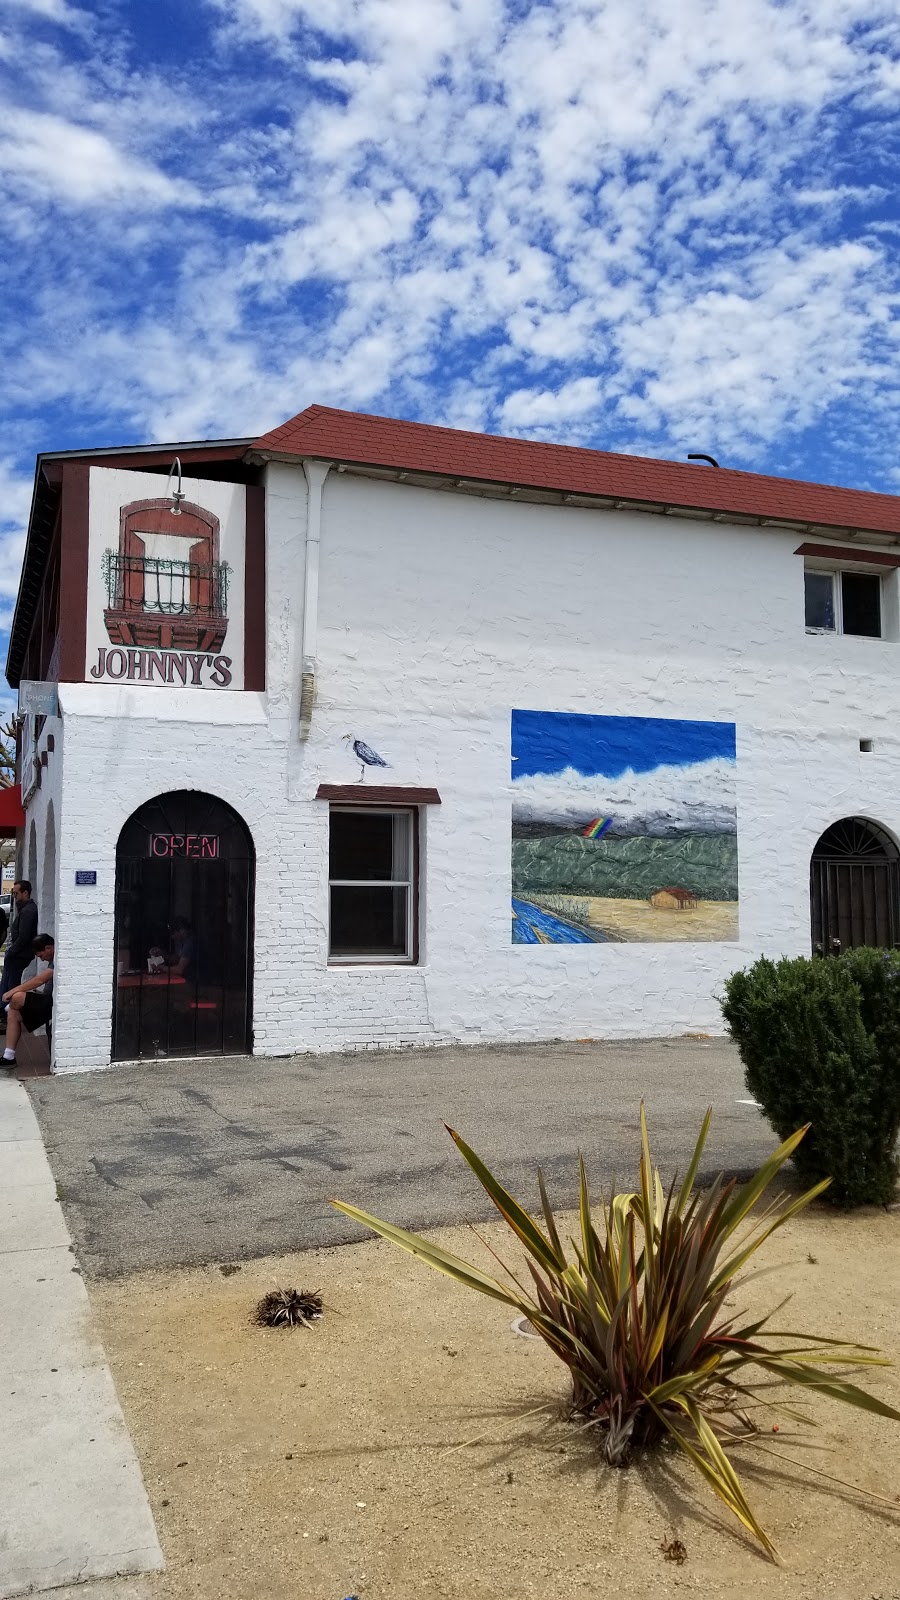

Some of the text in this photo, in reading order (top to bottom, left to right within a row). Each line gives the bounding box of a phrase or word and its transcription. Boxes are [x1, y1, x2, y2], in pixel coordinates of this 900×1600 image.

[90, 647, 232, 687] JOHNNY'S
[27, 694, 55, 702] PHONE
[153, 835, 217, 858] OPEN
